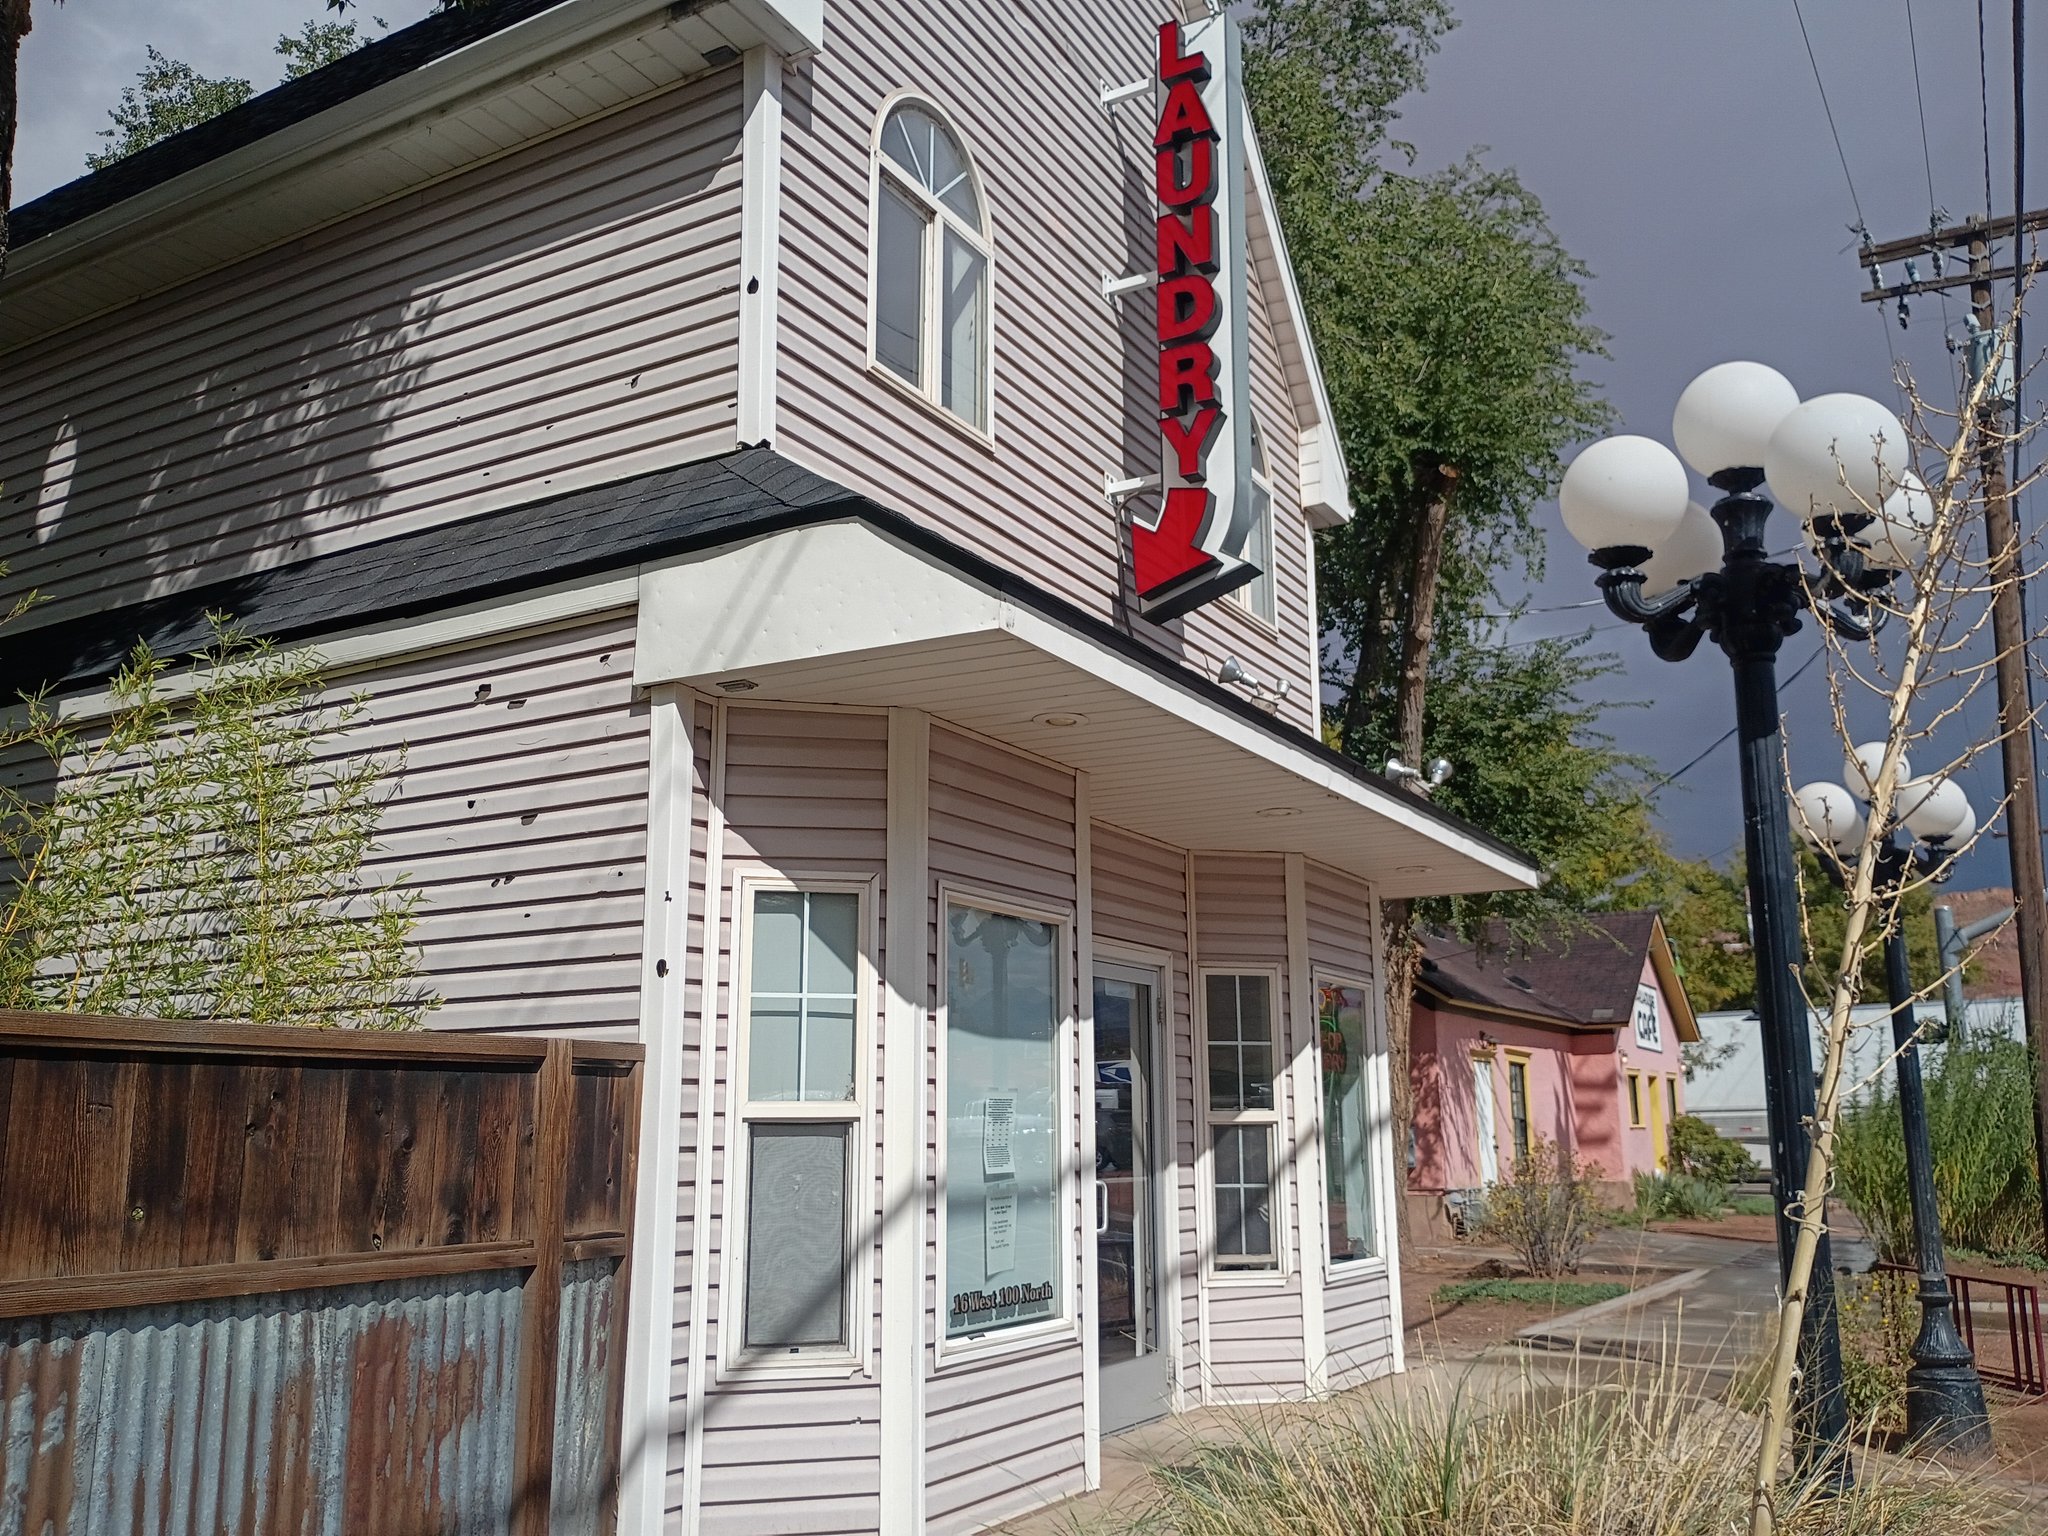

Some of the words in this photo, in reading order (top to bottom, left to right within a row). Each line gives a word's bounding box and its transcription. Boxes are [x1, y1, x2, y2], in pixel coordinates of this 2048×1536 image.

[1152, 20, 1226, 483] LAUNDRY
[953, 1292, 970, 1315] 16
[969, 1290, 997, 1312] West
[998, 1285, 1020, 1308] 100
[1020, 1281, 1053, 1303] North
